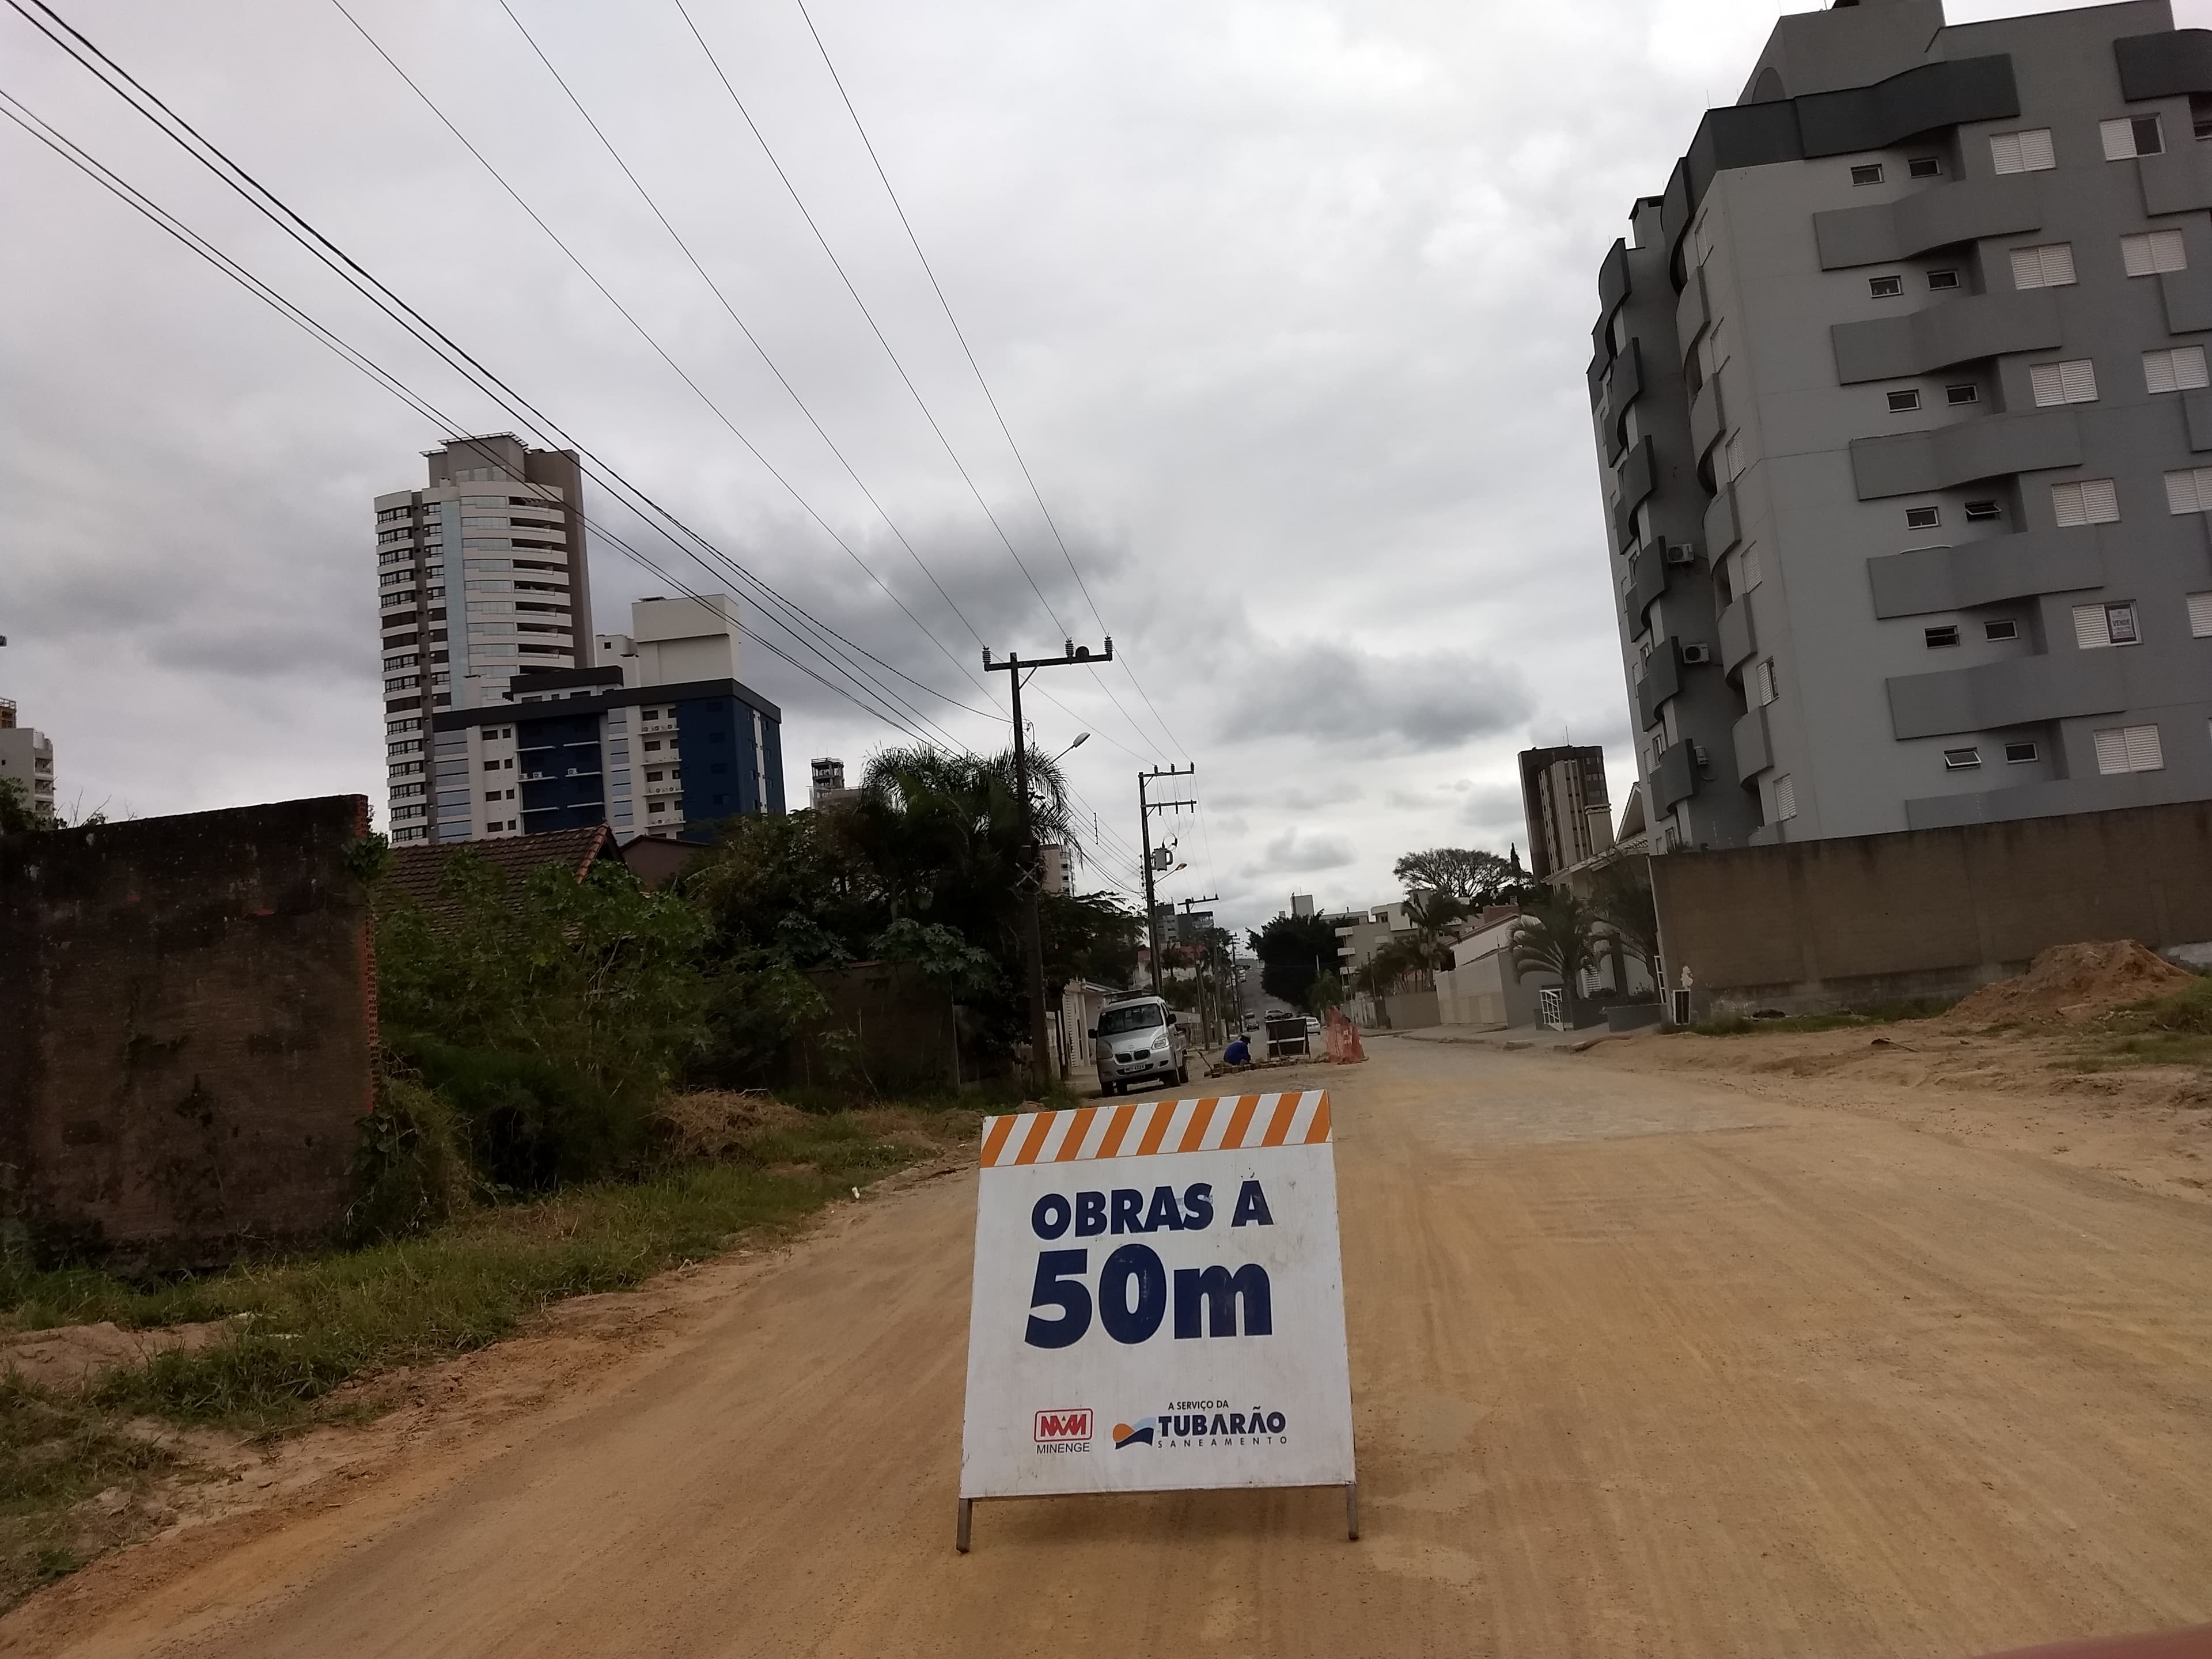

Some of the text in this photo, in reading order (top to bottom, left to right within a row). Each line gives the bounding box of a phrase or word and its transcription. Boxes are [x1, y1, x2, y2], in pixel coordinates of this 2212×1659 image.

[1031, 1182, 1214, 1241] OBRAS
[1024, 1243, 1273, 1349] 50m
[1168, 1399, 1229, 1412] A SERVIÇO DA
[1158, 1406, 1286, 1437] TUBARÃO
[1036, 1442, 1090, 1455] MINENGE
[1158, 1436, 1287, 1448] SANEAMENTO
